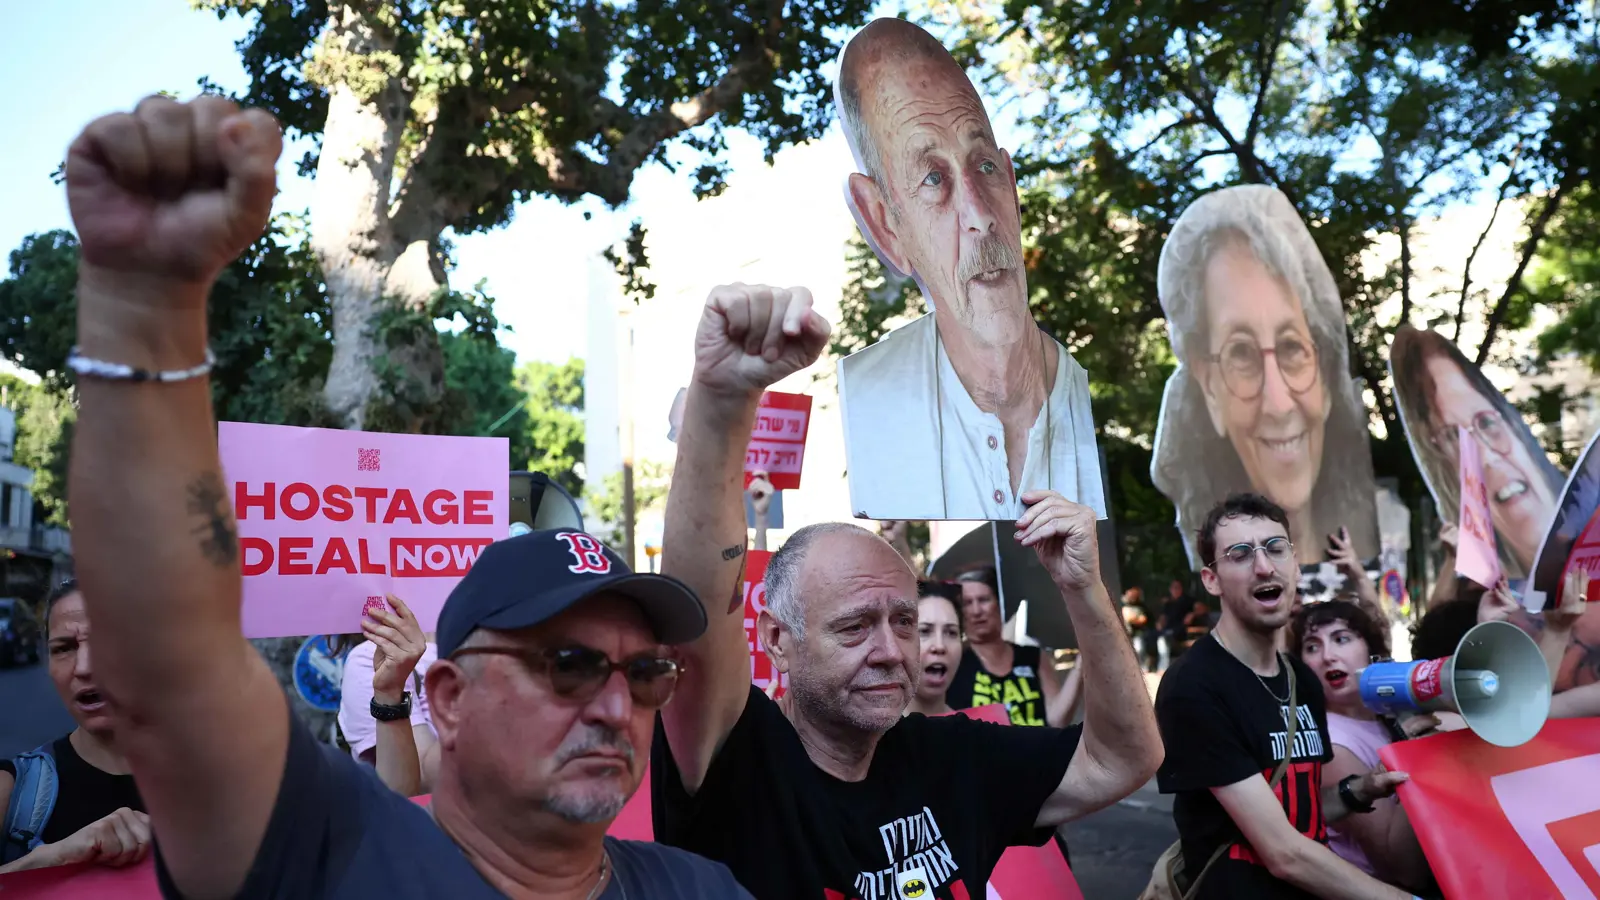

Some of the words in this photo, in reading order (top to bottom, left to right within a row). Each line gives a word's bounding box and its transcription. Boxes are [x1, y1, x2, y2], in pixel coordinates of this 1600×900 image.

[746, 448, 771, 465] לה
[235, 481, 494, 525] HOSTAGE
[240, 537, 387, 576] DEAL
[396, 545, 486, 571] NOW
[555, 532, 611, 574] B
[972, 694, 1045, 727] DAL
